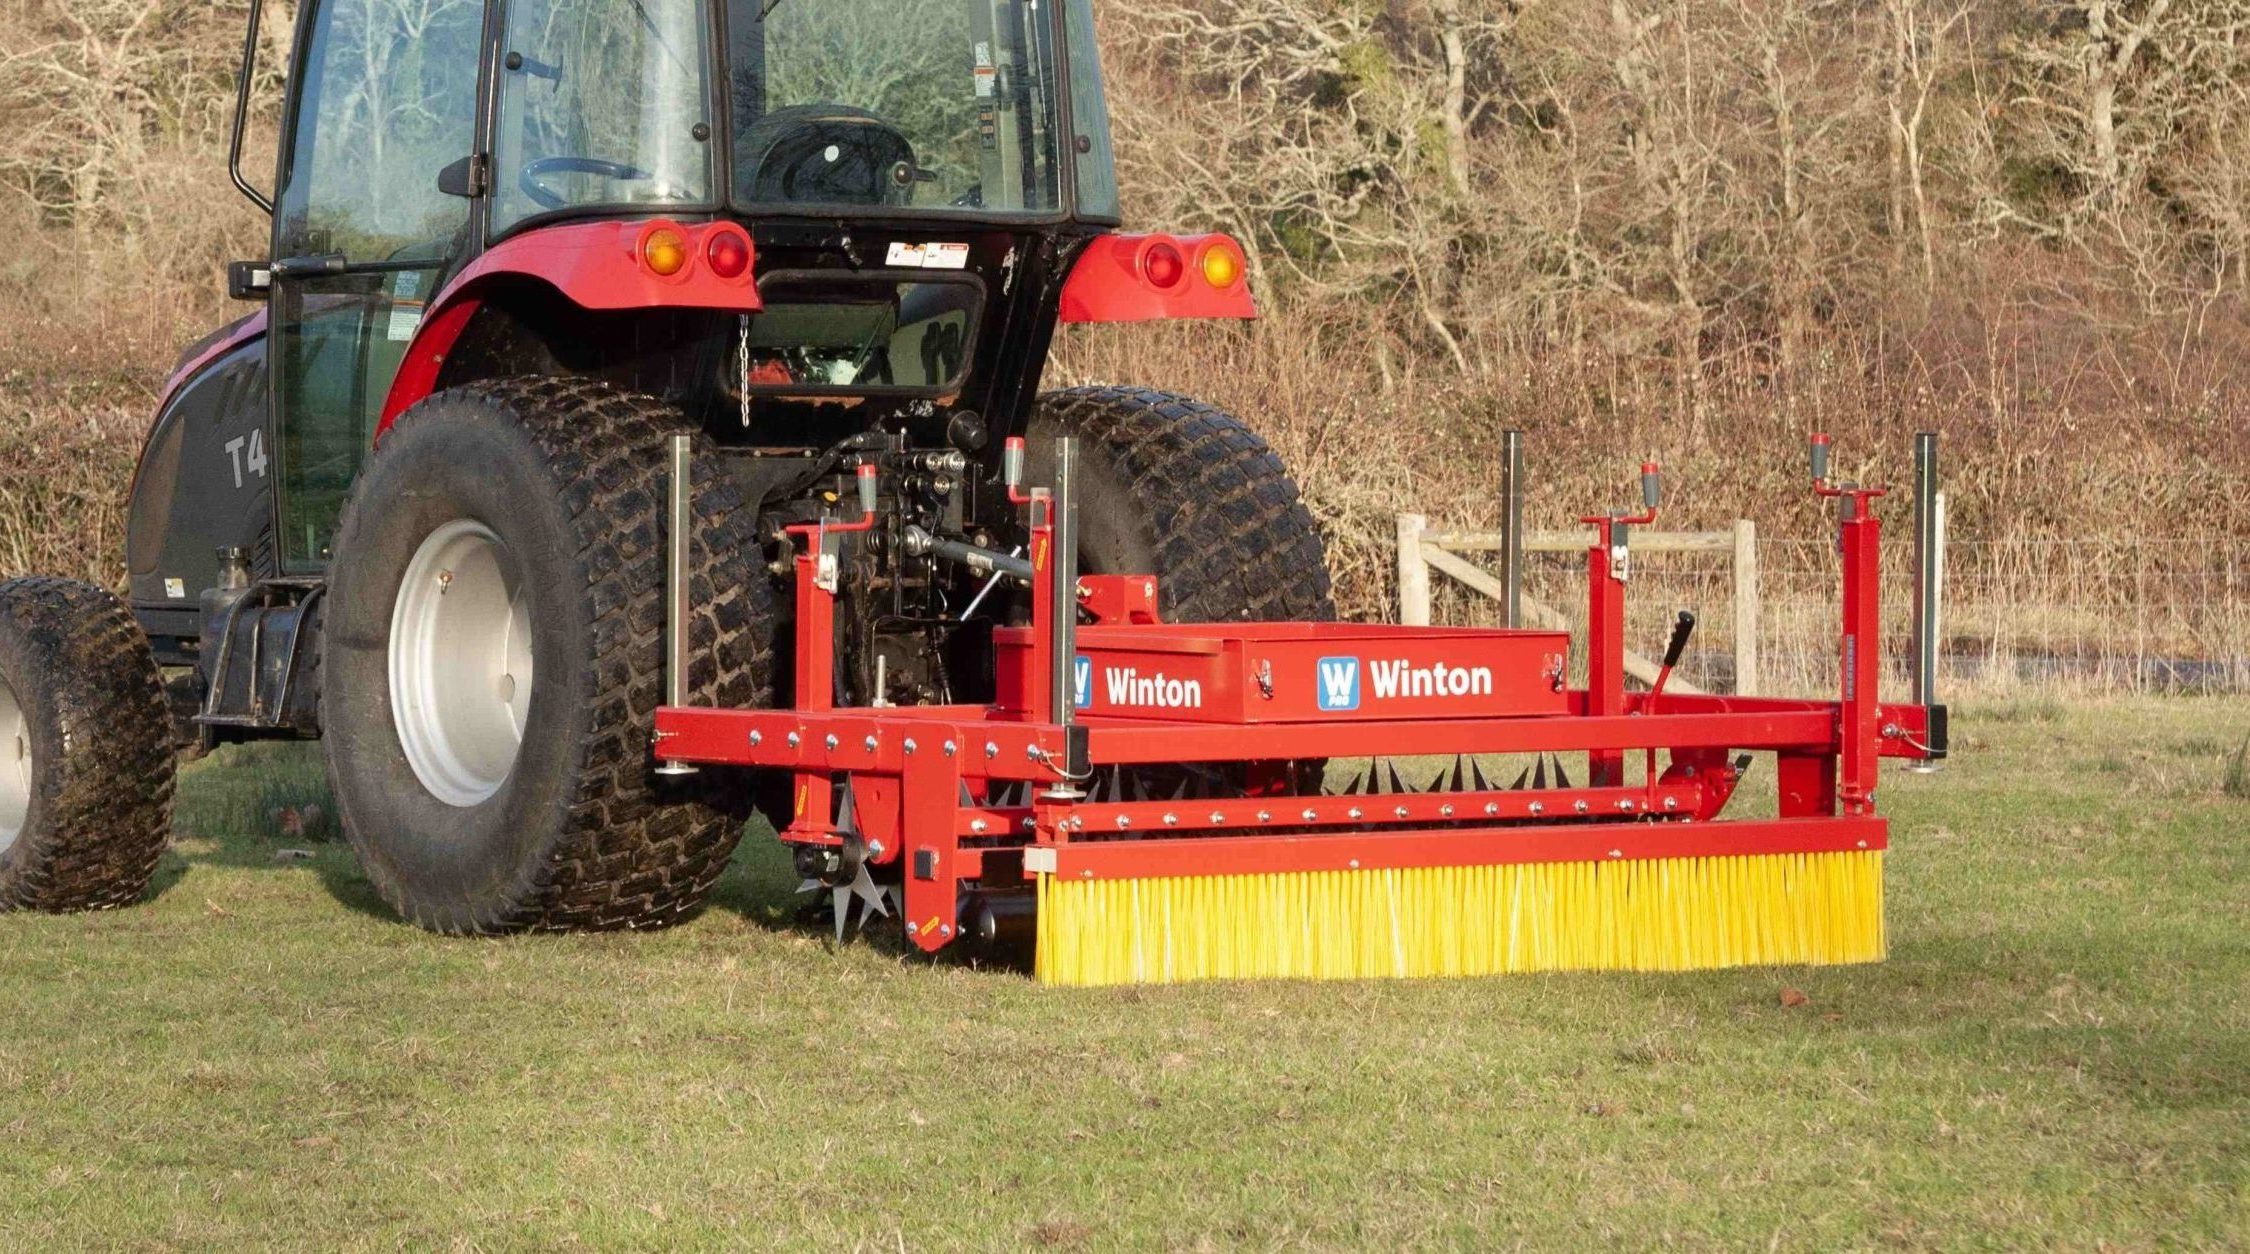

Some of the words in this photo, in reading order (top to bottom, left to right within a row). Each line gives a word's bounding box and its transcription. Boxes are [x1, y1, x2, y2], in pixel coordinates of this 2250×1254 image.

[1106, 667, 1201, 707] Winton
[1321, 662, 1356, 696] W
[1370, 659, 1492, 698] Winton
[1328, 694, 1350, 707] PRO
